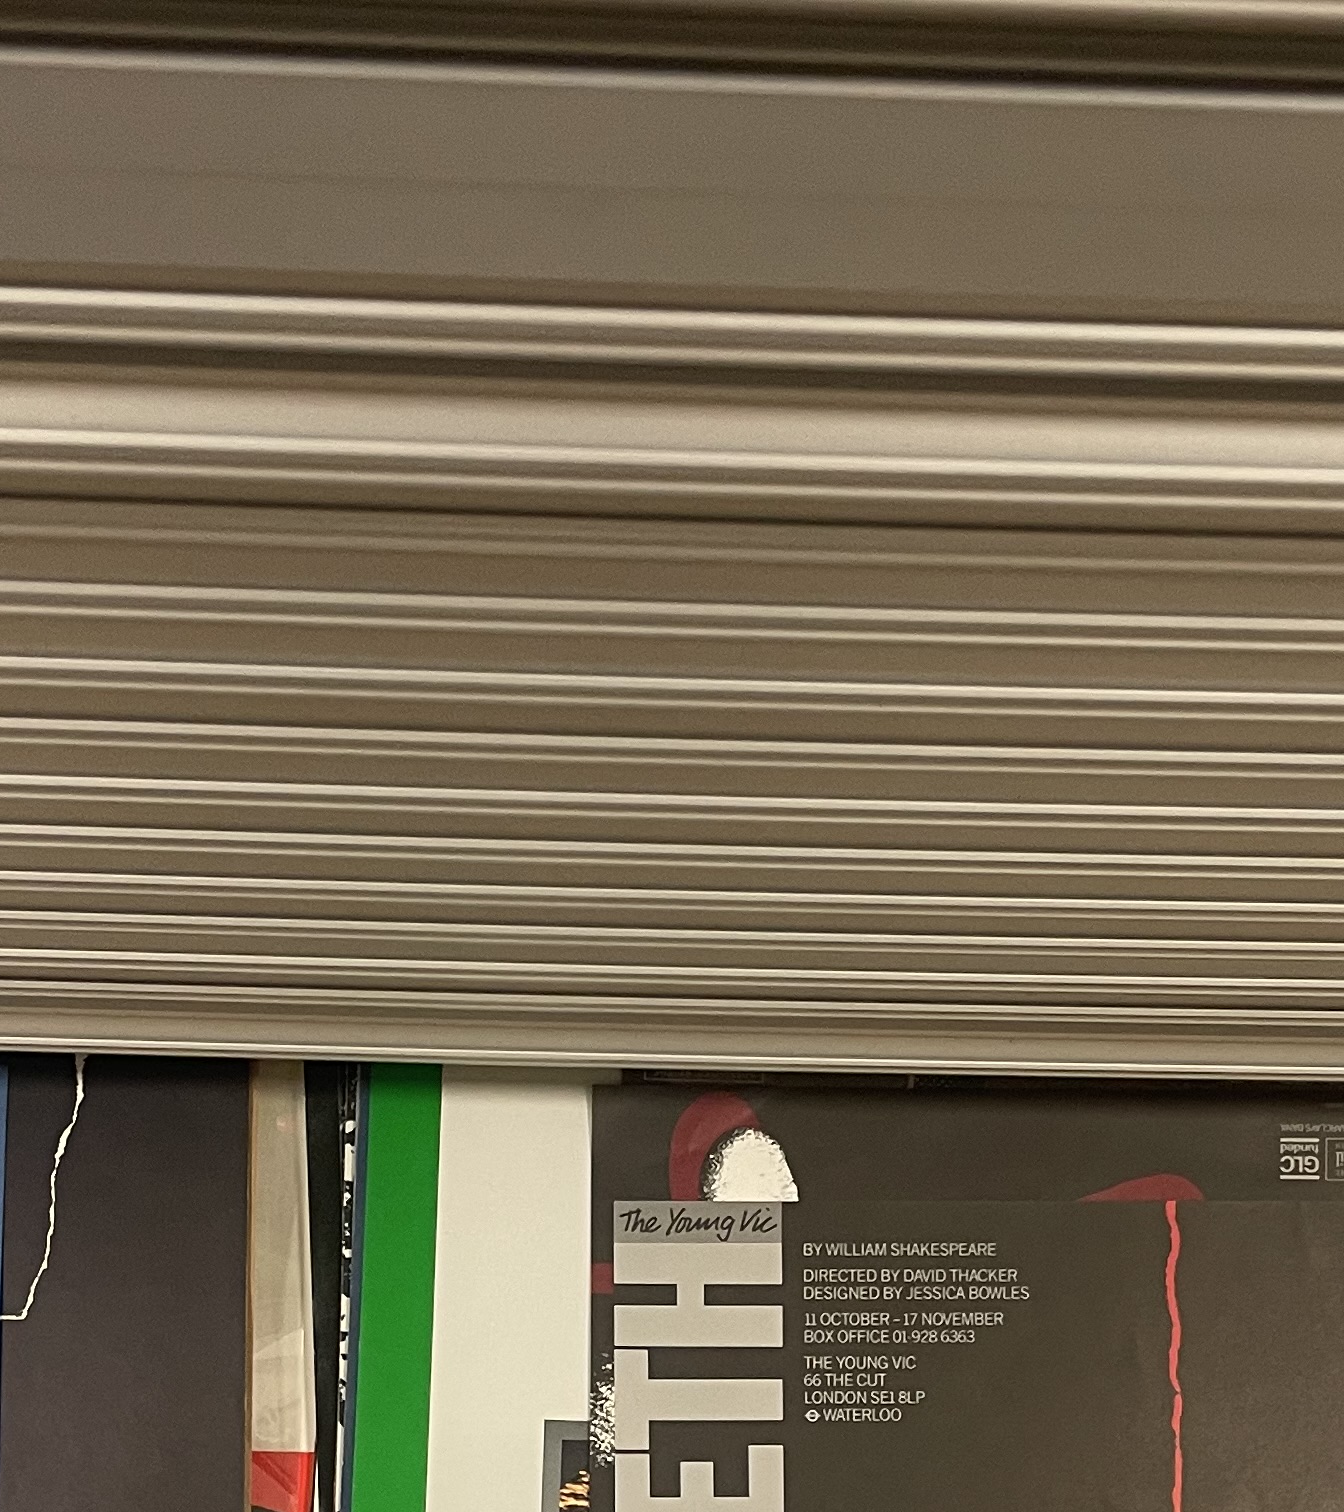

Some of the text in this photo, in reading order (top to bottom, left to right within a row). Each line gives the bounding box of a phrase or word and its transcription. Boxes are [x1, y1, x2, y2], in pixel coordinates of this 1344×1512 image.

[1280, 1144, 1319, 1154] funded
[1280, 1156, 1319, 1173] GLC
[619, 1207, 777, 1242] The Young Vic
[803, 1243, 997, 1256] BY WILLIAM SHAKESPEARE
[803, 1269, 1017, 1282] DIRECTED BY DAVID THACKER
[803, 1286, 1029, 1299] DESIGNED BY JESSICA BOWLES
[805, 1313, 816, 1326] 11
[820, 1313, 889, 1326] OCTOBER
[904, 1313, 917, 1326] 17
[921, 1313, 1003, 1325] NOVEMBER
[804, 1330, 834, 1343] BOX
[837, 1330, 889, 1343] OFFICE
[941, 1330, 975, 1343] 6363
[804, 1356, 917, 1369] THE YOUNG VIC
[804, 1373, 886, 1386] 66 THE CUT
[805, 1391, 925, 1404] LONDON SE1 8LP
[823, 1409, 901, 1421] WATERLOO
